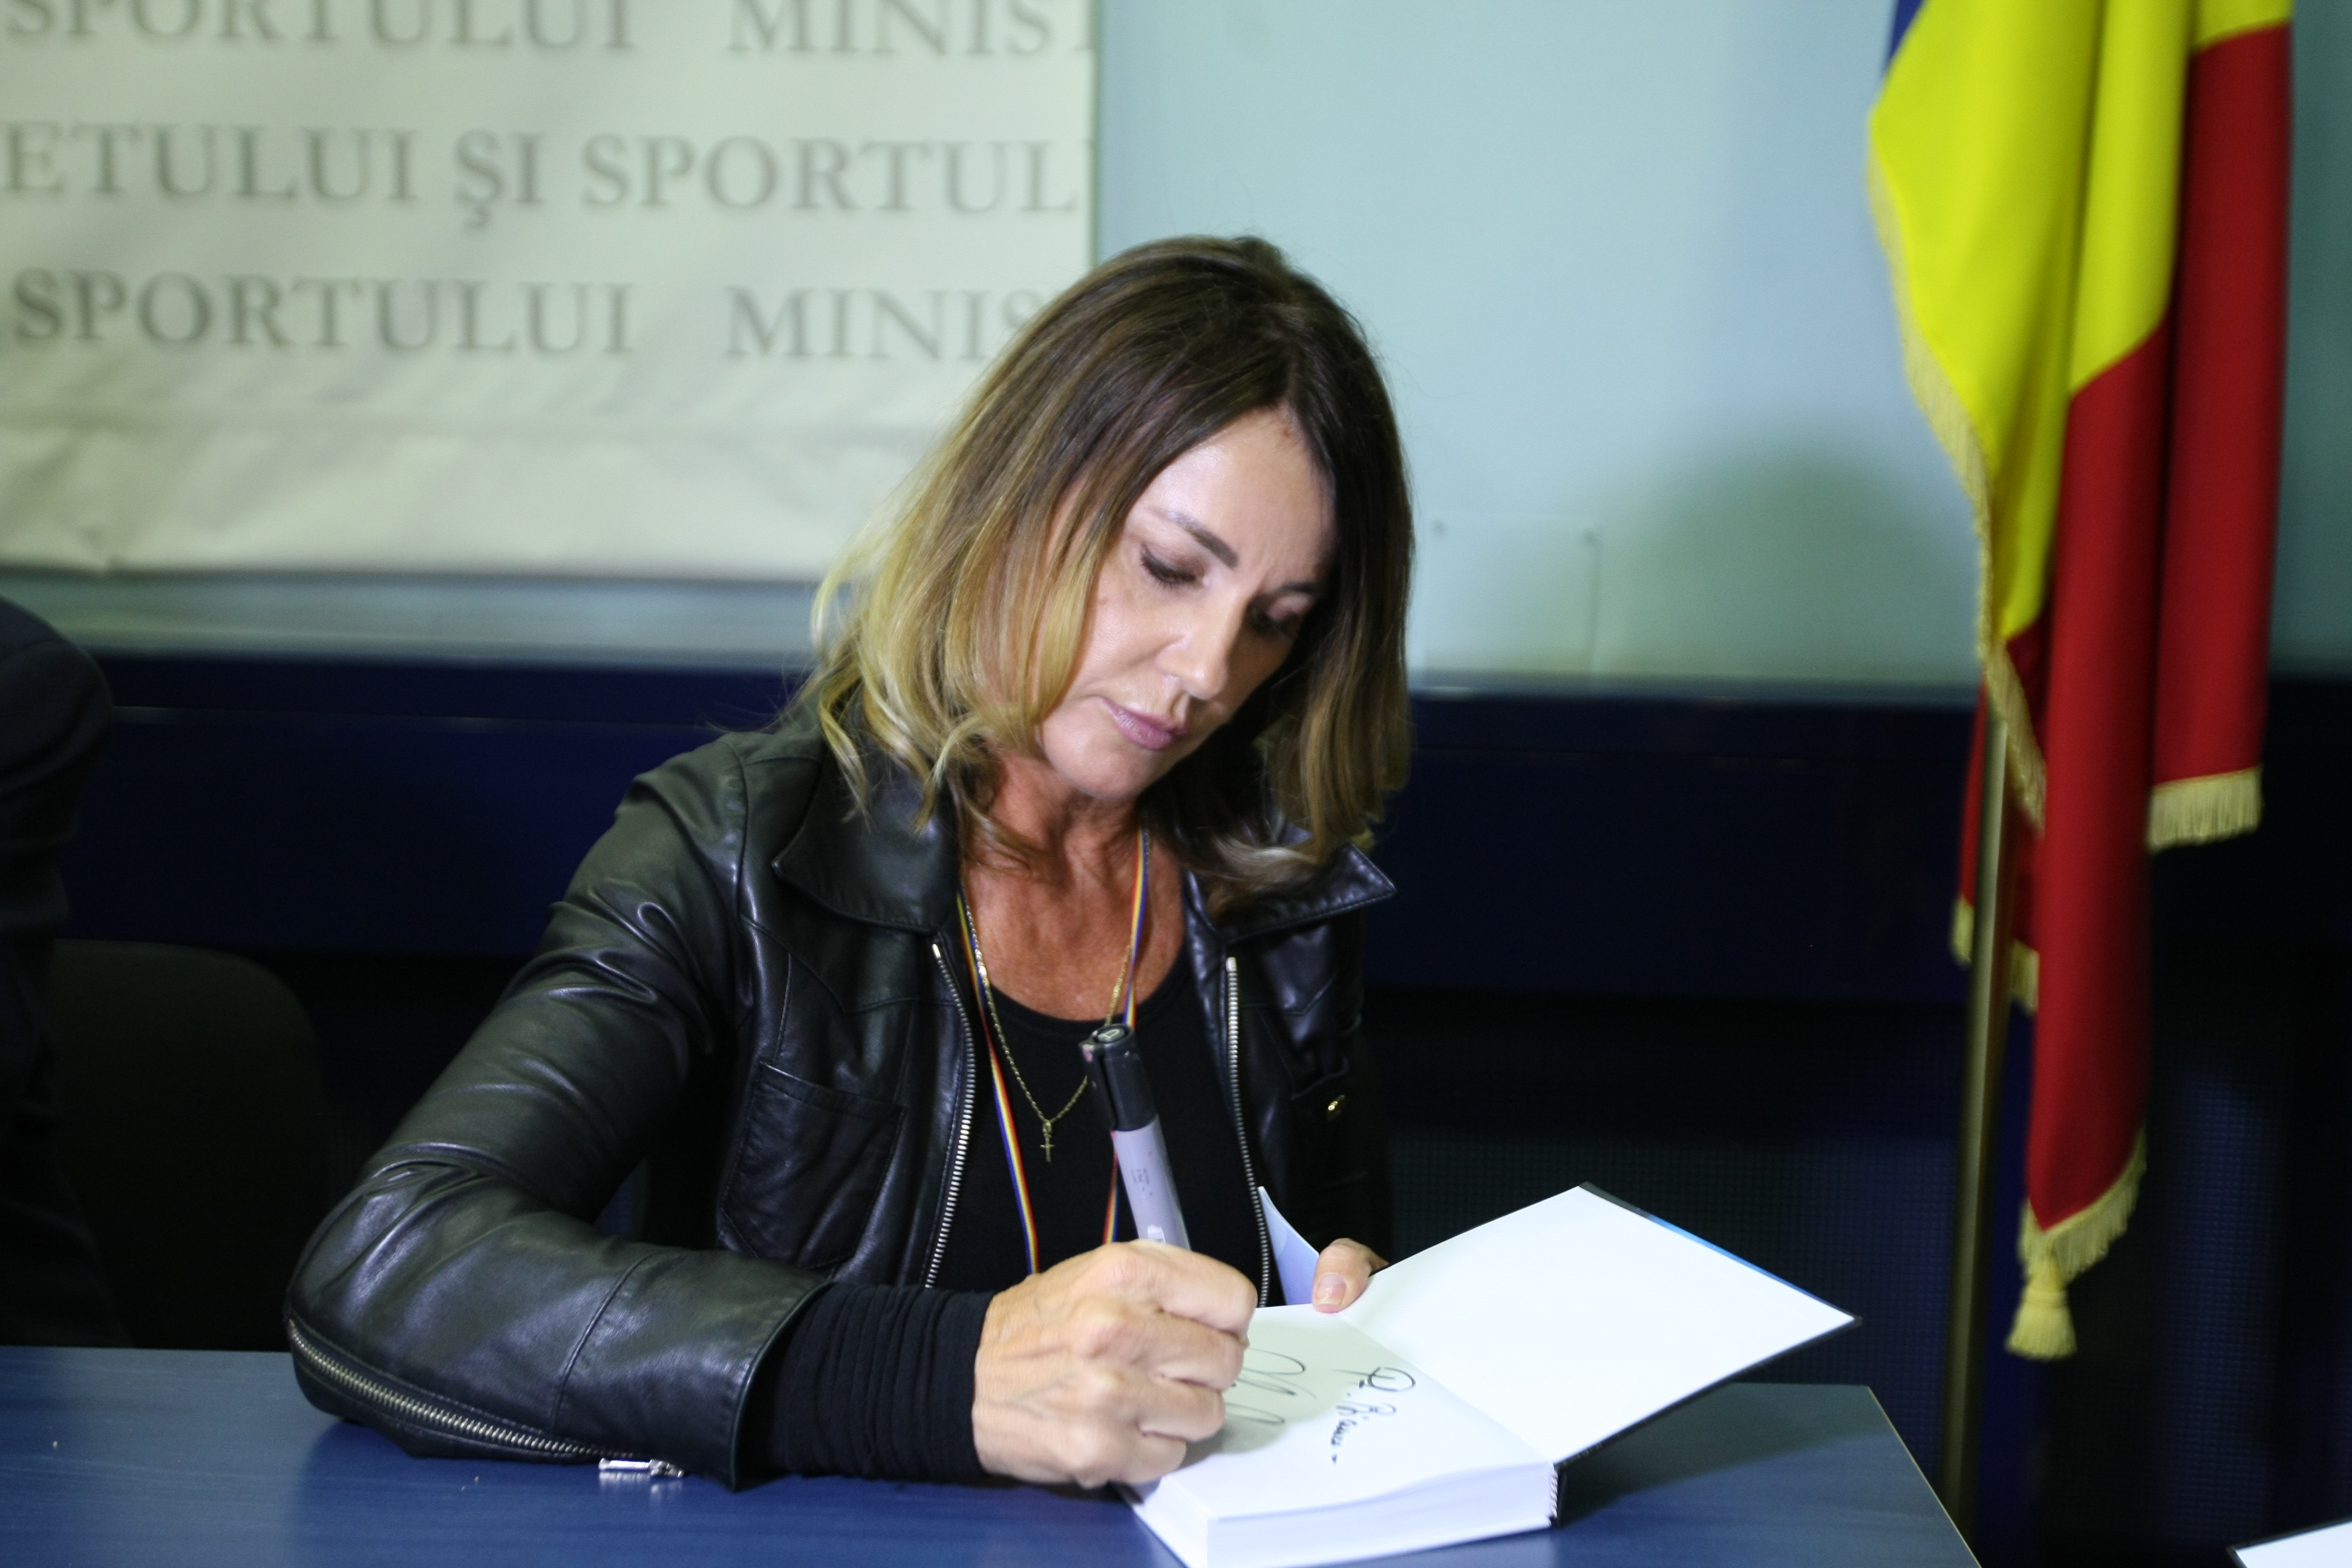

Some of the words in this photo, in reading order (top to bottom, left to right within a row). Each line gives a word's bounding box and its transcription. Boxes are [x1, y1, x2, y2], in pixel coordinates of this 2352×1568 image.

[1, 121, 420, 202] ETULUI
[580, 133, 1094, 214] SPORTUL
[11, 267, 635, 353] SPORTULUI
